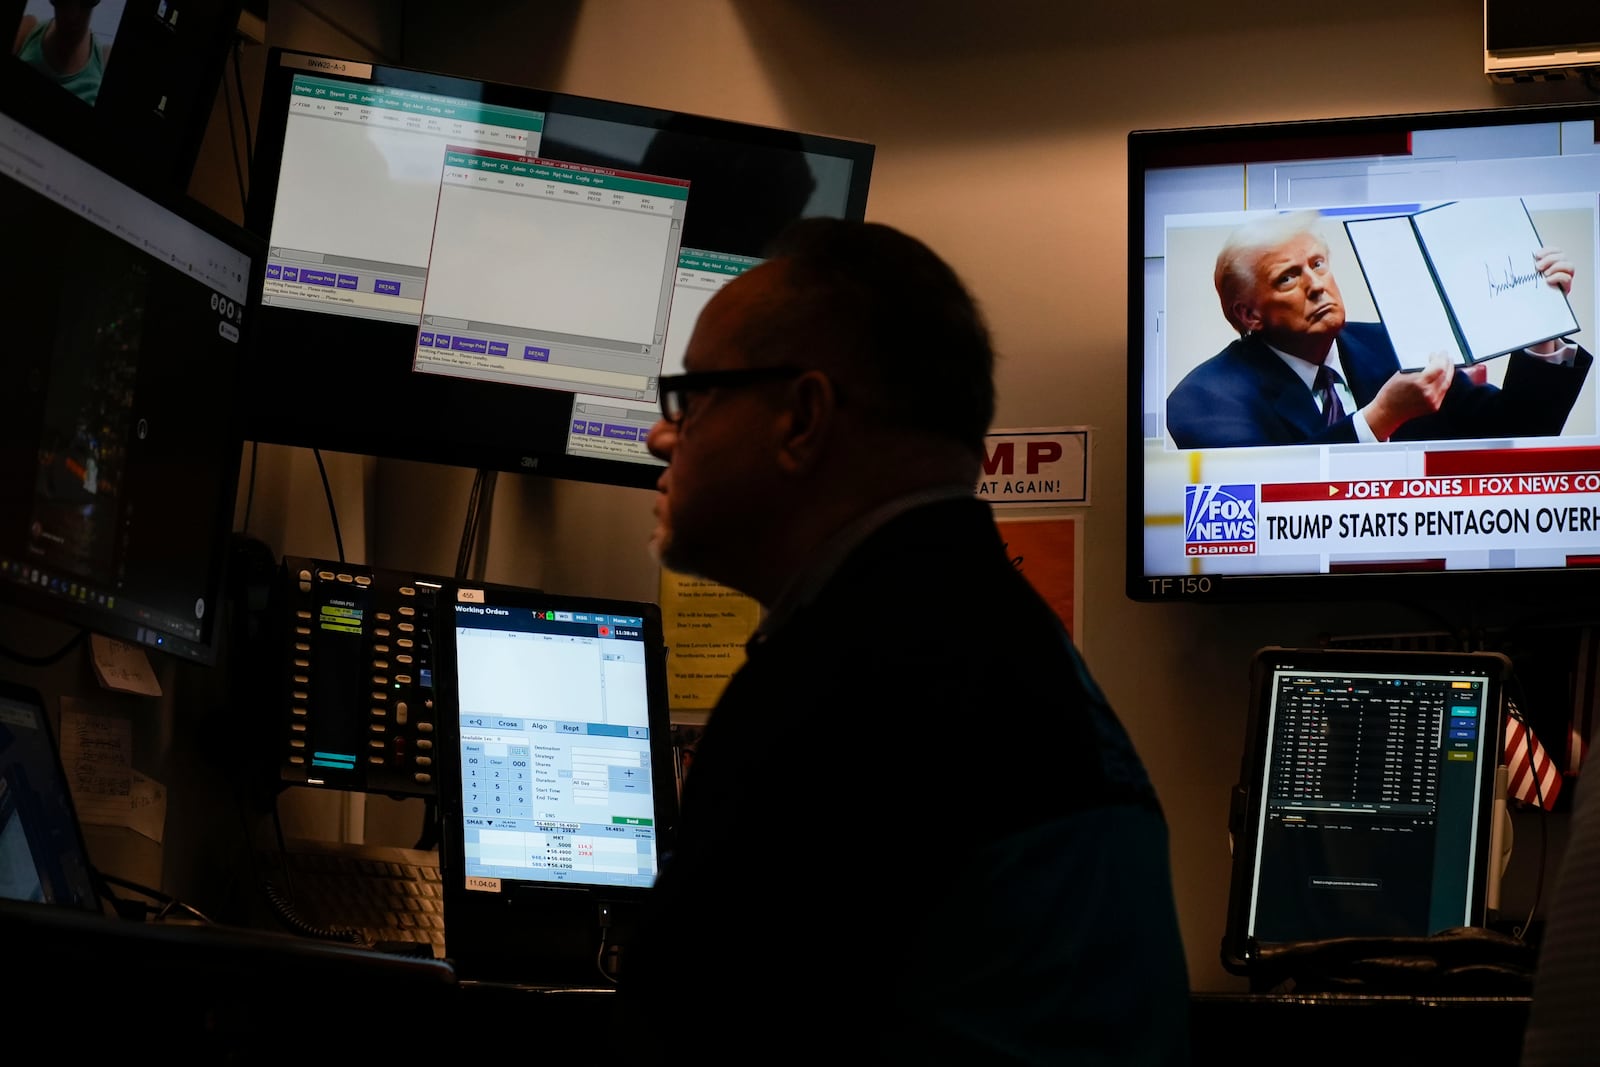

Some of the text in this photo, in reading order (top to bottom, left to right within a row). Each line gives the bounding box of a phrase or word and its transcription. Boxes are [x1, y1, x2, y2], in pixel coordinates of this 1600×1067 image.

[482, 161, 497, 169] Report
[576, 175, 590, 183] Config
[527, 350, 546, 358] DETAIL
[975, 480, 1060, 494] AT AGAIN!
[1344, 474, 1600, 499] JOEY JONES FOX NEWS CO
[1208, 500, 1253, 521] FOX
[1196, 521, 1255, 541] NEWS
[1266, 515, 1333, 541] TRUMP
[1338, 511, 1409, 538] STARTS
[1415, 507, 1529, 537] PENTAGON
[1187, 543, 1254, 556] channel
[1148, 577, 1212, 595] TF 150
[455, 605, 510, 617] Working Orders
[469, 719, 580, 733] e-Q Cross Algo Rept
[469, 879, 497, 889] 11.04.04
